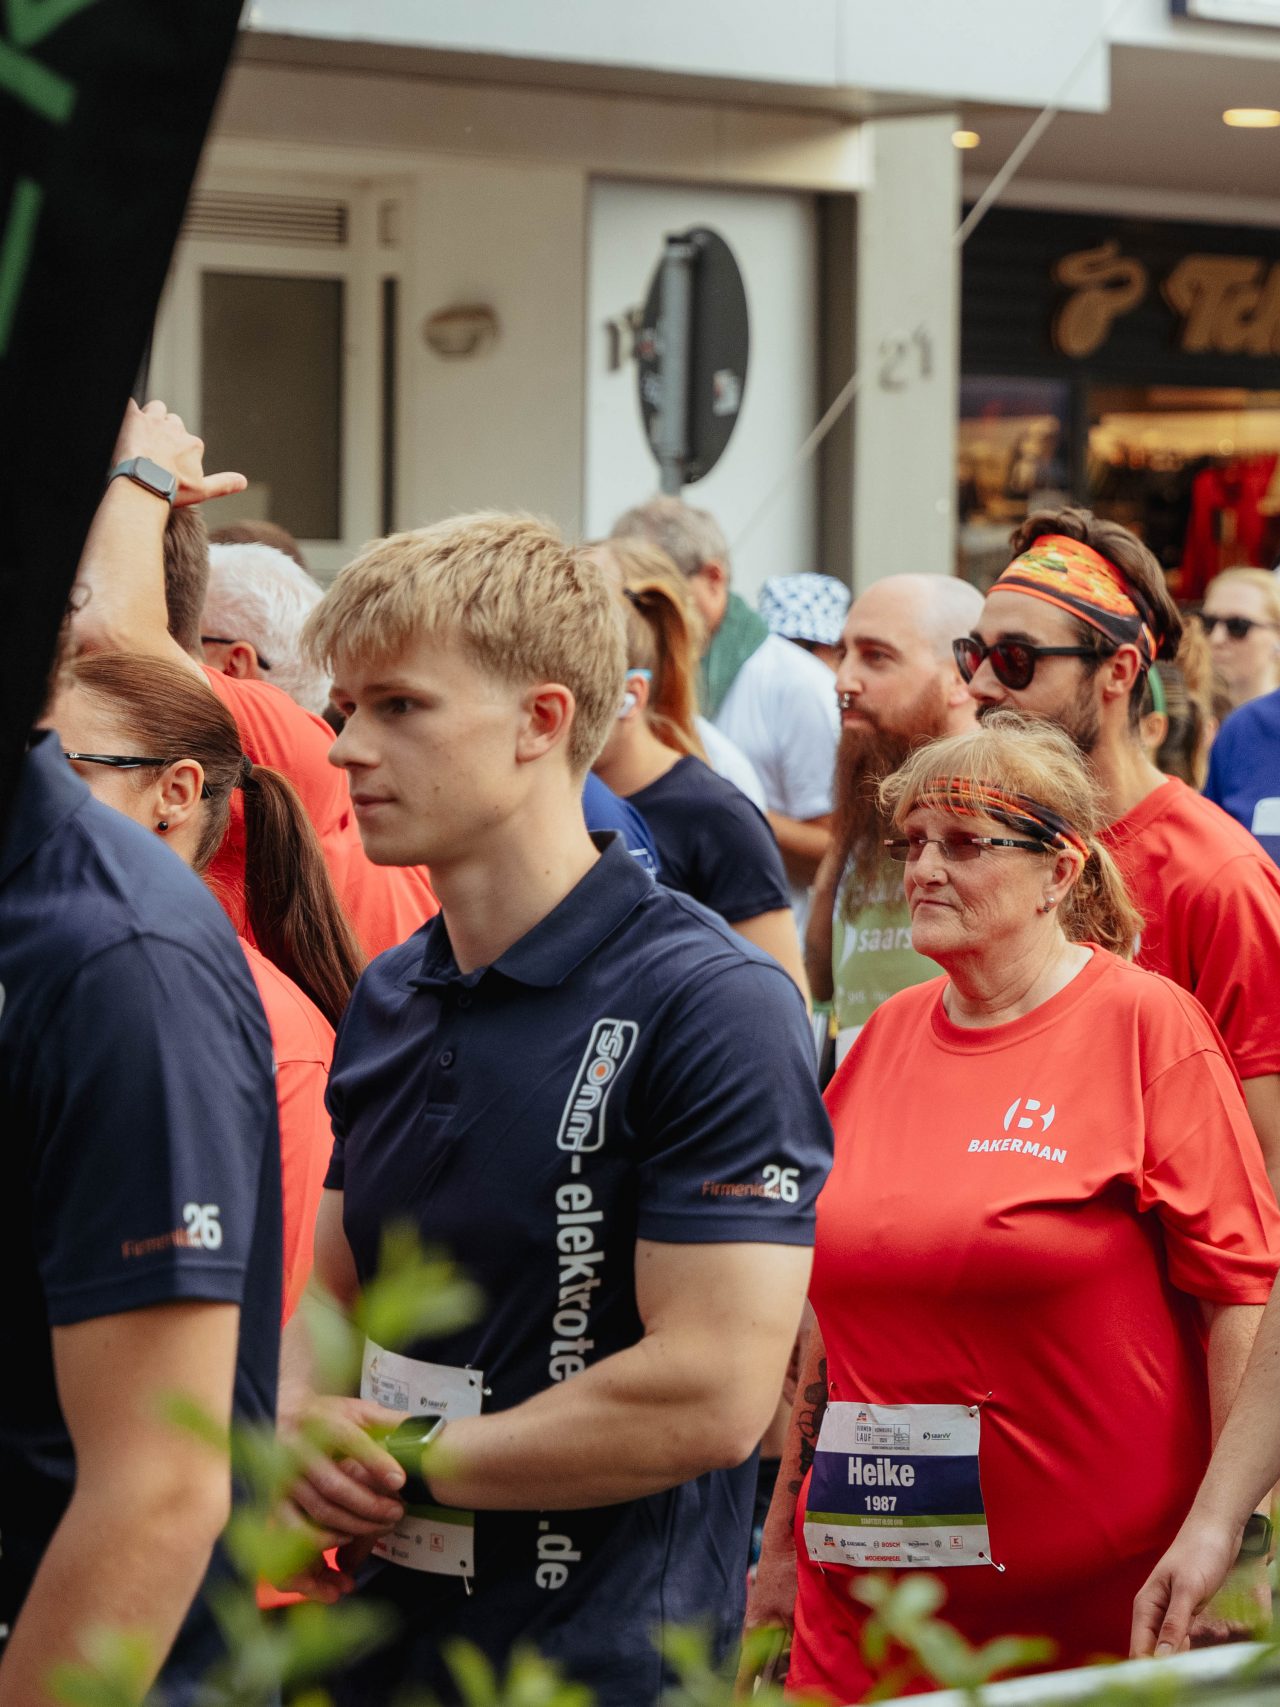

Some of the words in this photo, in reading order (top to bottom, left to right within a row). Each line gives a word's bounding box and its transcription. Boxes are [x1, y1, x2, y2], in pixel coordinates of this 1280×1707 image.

[879, 326, 934, 394] 21
[967, 1138, 1067, 1164] BAKERMAN
[762, 1163, 800, 1203] 26
[183, 1201, 222, 1250] 26
[856, 1433, 872, 1442] LAUF
[848, 1456, 916, 1487] Heike
[864, 1495, 898, 1512] 1987
